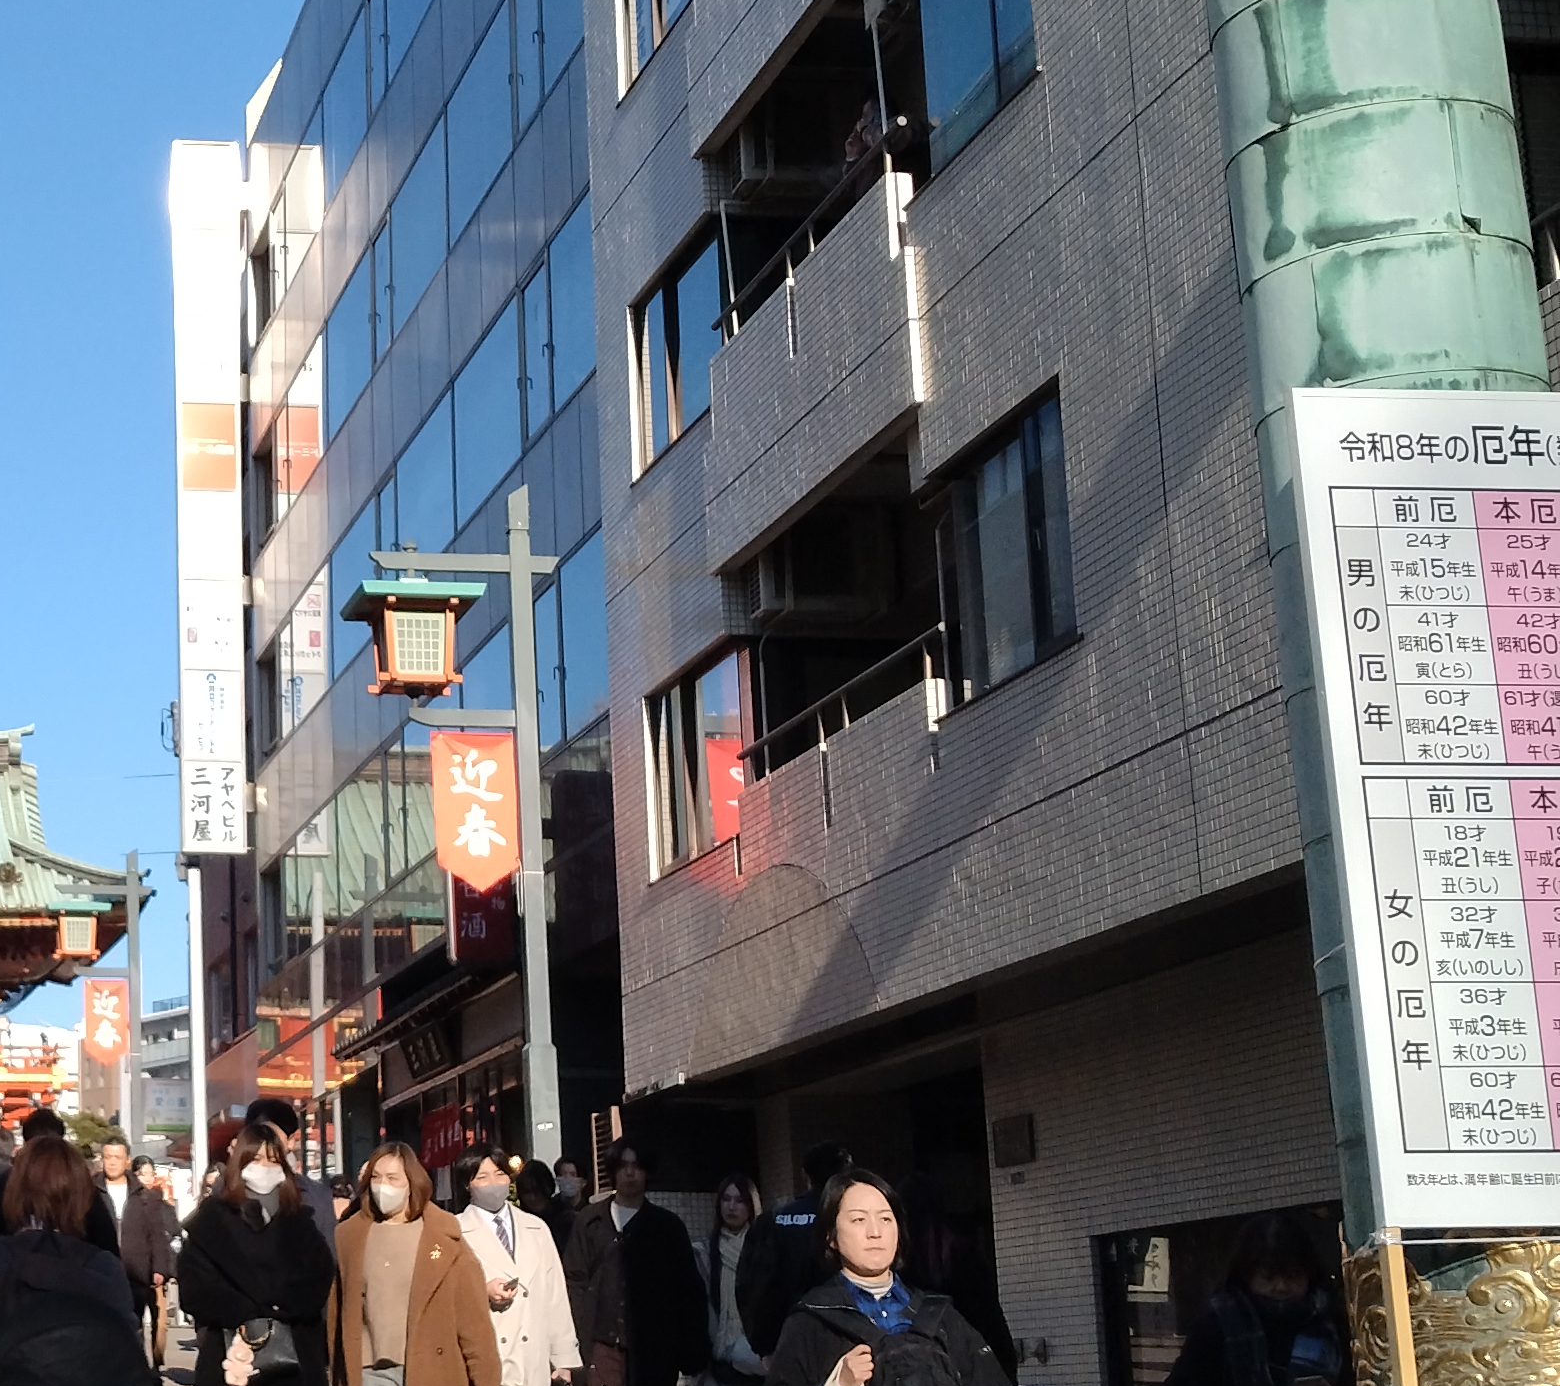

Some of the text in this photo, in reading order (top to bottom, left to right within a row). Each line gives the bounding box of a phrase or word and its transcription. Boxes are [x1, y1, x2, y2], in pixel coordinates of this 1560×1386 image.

[1339, 424, 1560, 467] 令和8年の厄年(
[1406, 533, 1452, 550] 24才
[1506, 534, 1551, 551] 25才
[1390, 558, 1476, 580] 平成15年生
[1399, 585, 1471, 603] 未(ひつじ)
[1417, 613, 1458, 629] 41才
[1347, 558, 1393, 732] 男の厄年
[1397, 632, 1487, 654] 昭和61年生
[1497, 633, 1560, 654] 昭和60
[1415, 661, 1473, 680] 寅(とら)
[1424, 689, 1470, 708] 60才
[1405, 715, 1500, 737] 昭和42年生
[1417, 742, 1490, 761] 未(ひつじ)
[190, 766, 213, 843] 三河屋
[449, 749, 507, 858] 迎春
[1529, 785, 1557, 814] 本
[1443, 825, 1486, 843] 18才
[1422, 846, 1513, 868] 平成21年生
[1440, 877, 1499, 896] 丑(うし)
[1450, 905, 1497, 924] 32才
[1439, 928, 1515, 950] 平成7年生
[1435, 958, 1524, 979] 亥(いのしし)
[1383, 889, 1433, 1071] 女の厄年
[1459, 986, 1507, 1006] 36才
[91, 989, 123, 1049] 迎春
[1448, 1014, 1527, 1036] 平成3年生
[1452, 1042, 1526, 1063] 未(ひつじ)
[1469, 1071, 1517, 1090] 60才
[1448, 1098, 1545, 1121] 昭和42年生
[1461, 1128, 1537, 1147] 未(ひつじ)
